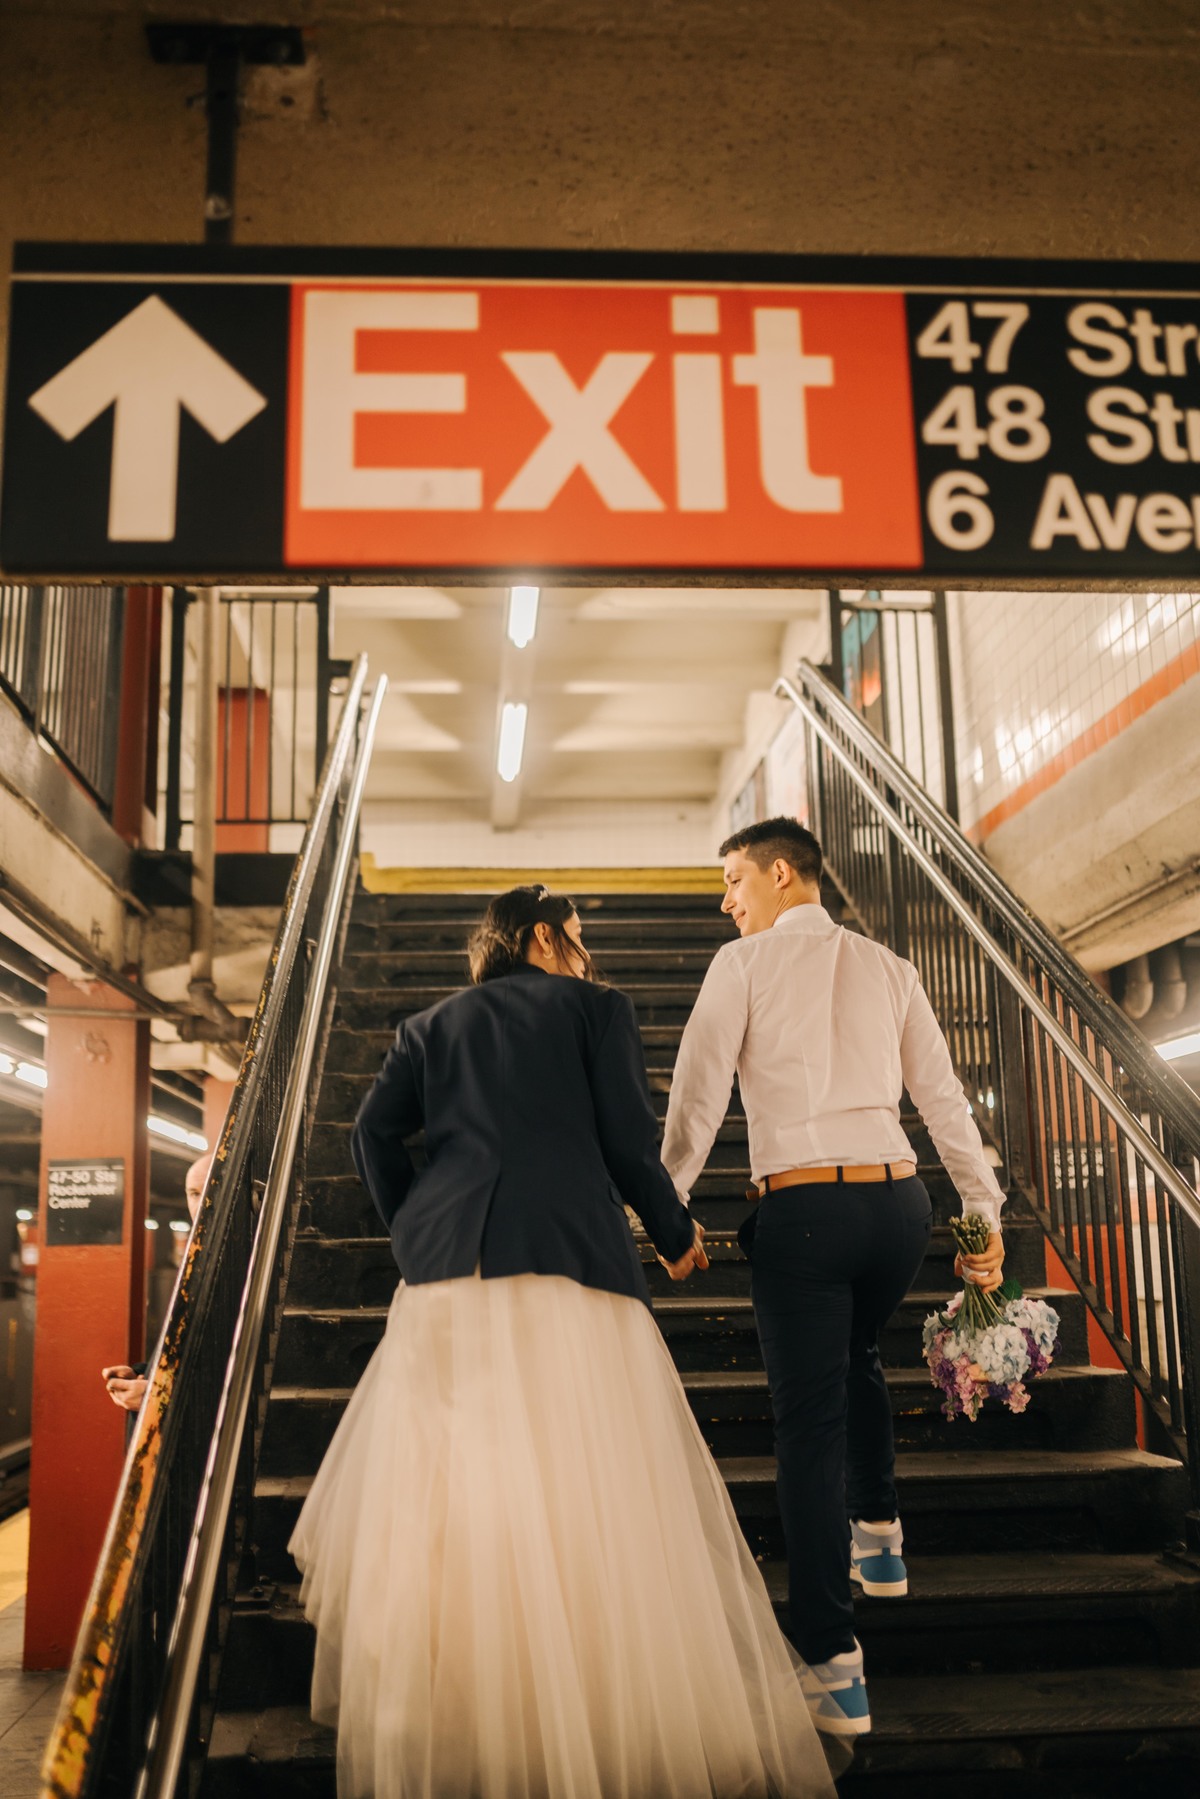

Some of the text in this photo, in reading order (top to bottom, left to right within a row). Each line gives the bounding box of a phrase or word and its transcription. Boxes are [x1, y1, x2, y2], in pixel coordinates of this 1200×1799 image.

[916, 301, 1200, 377] 47 Str
[301, 291, 844, 513] Exit
[921, 384, 1051, 462] 48
[927, 470, 1200, 553] 6 Ave
[48, 1196, 91, 1209] Center
[49, 1171, 90, 1183] 47-50
